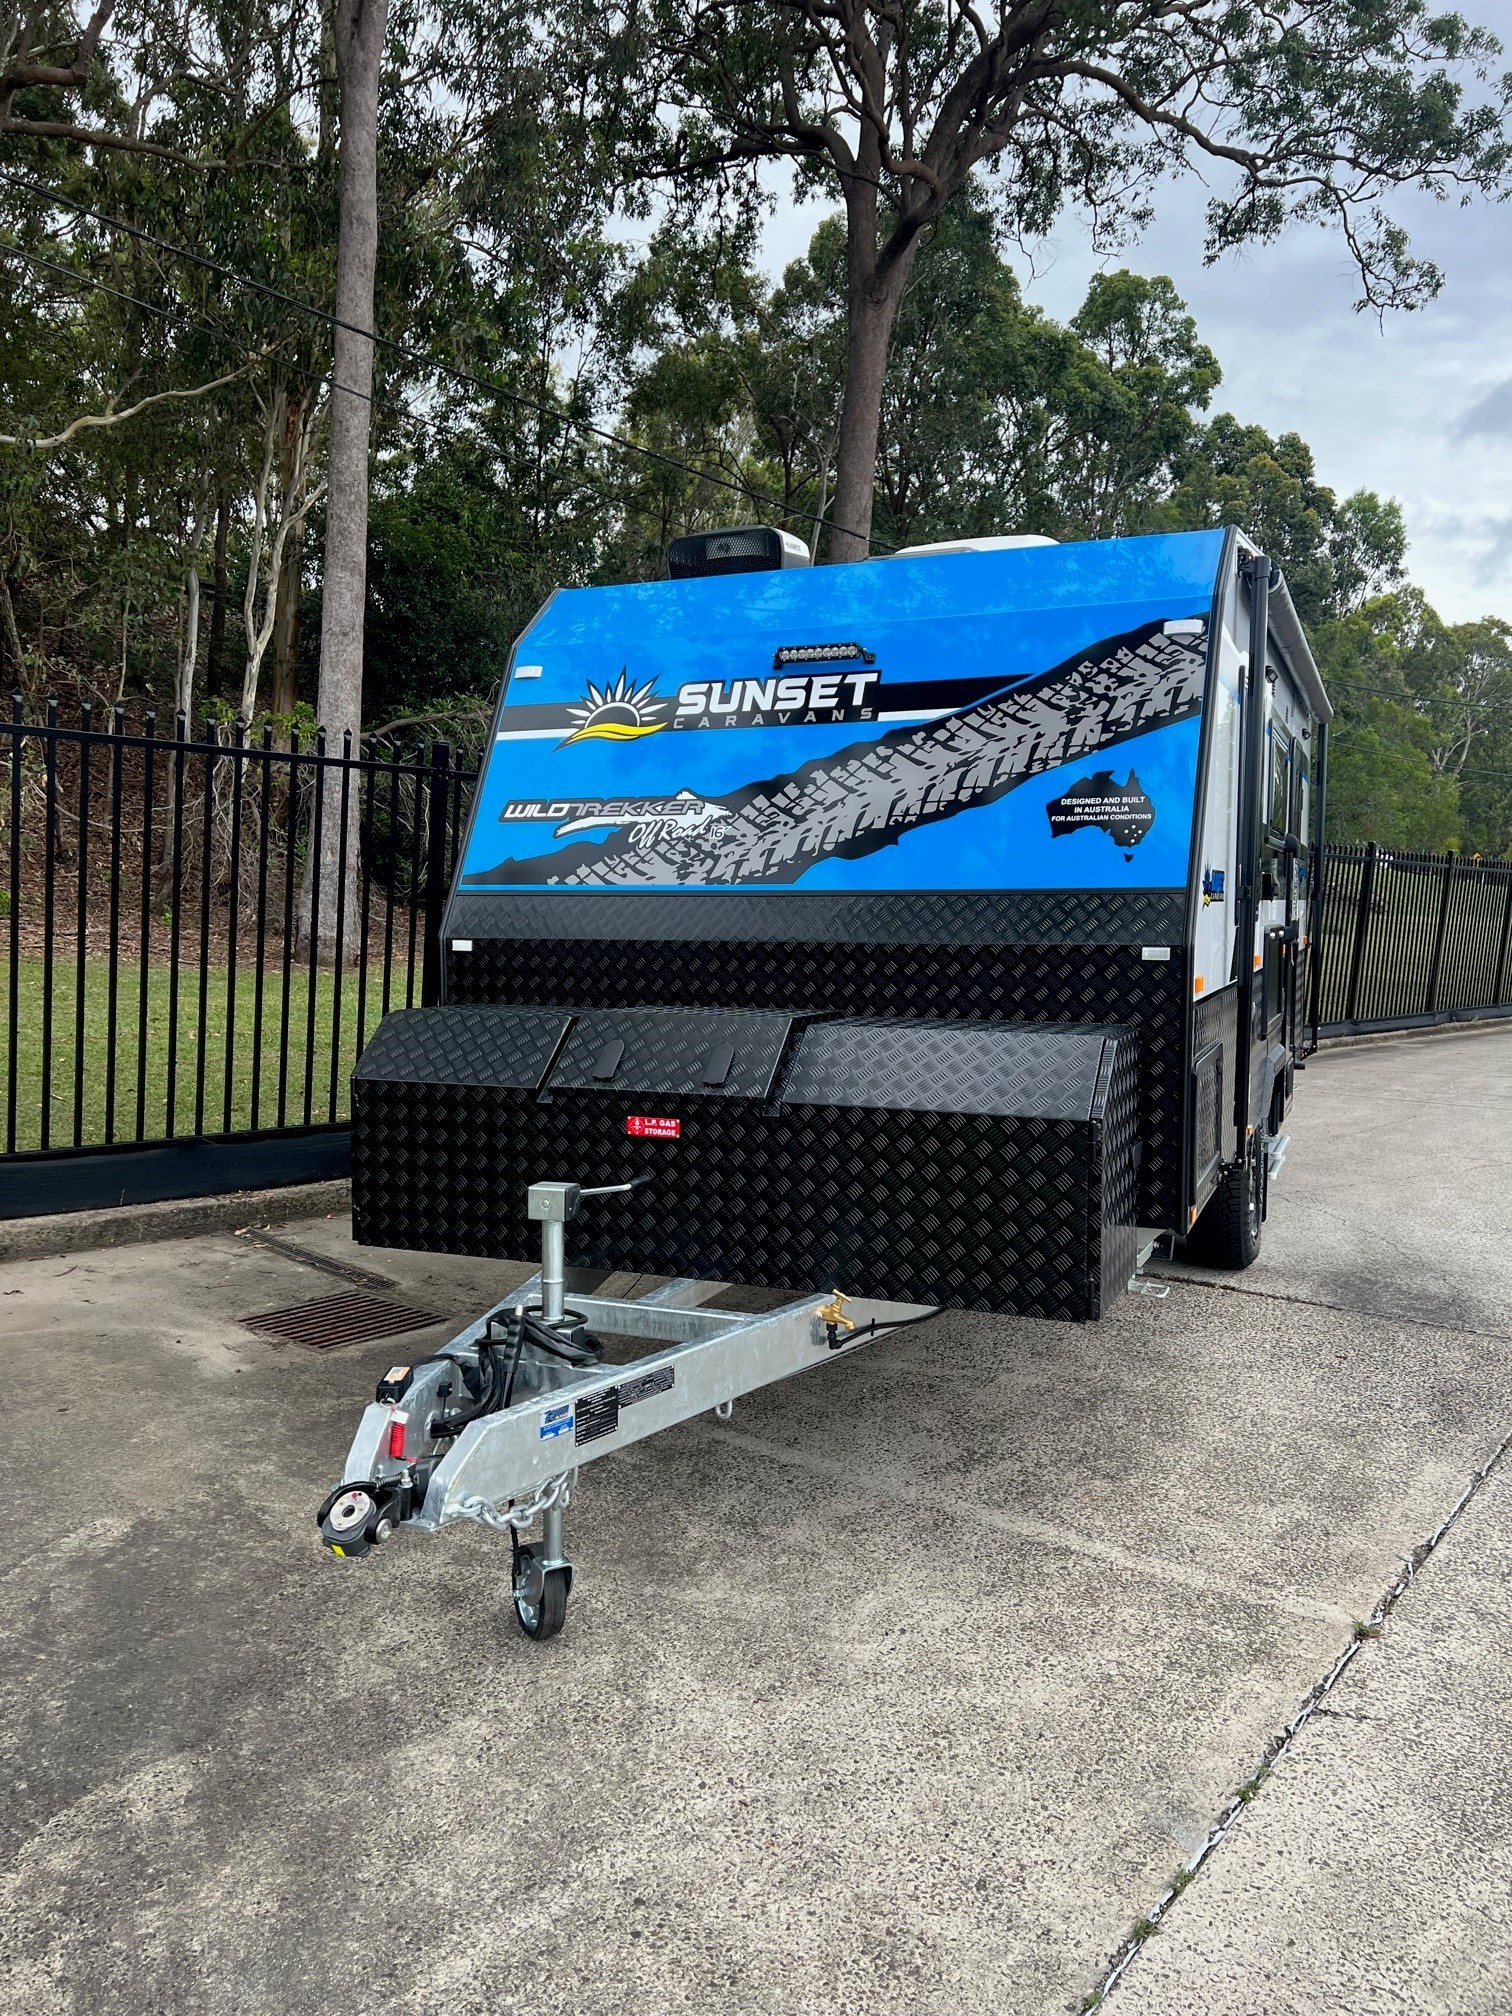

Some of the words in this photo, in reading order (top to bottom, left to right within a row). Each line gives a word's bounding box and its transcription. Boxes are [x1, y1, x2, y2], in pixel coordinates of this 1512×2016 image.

[676, 672, 878, 715] SUNSET
[673, 708, 873, 729] CARAVANS
[503, 800, 705, 818] WILDTREKKER
[1084, 805, 1129, 813] AUSTRALIA
[628, 819, 660, 848] Off
[658, 815, 713, 841] Road
[644, 1128, 676, 1136] STORAGE
